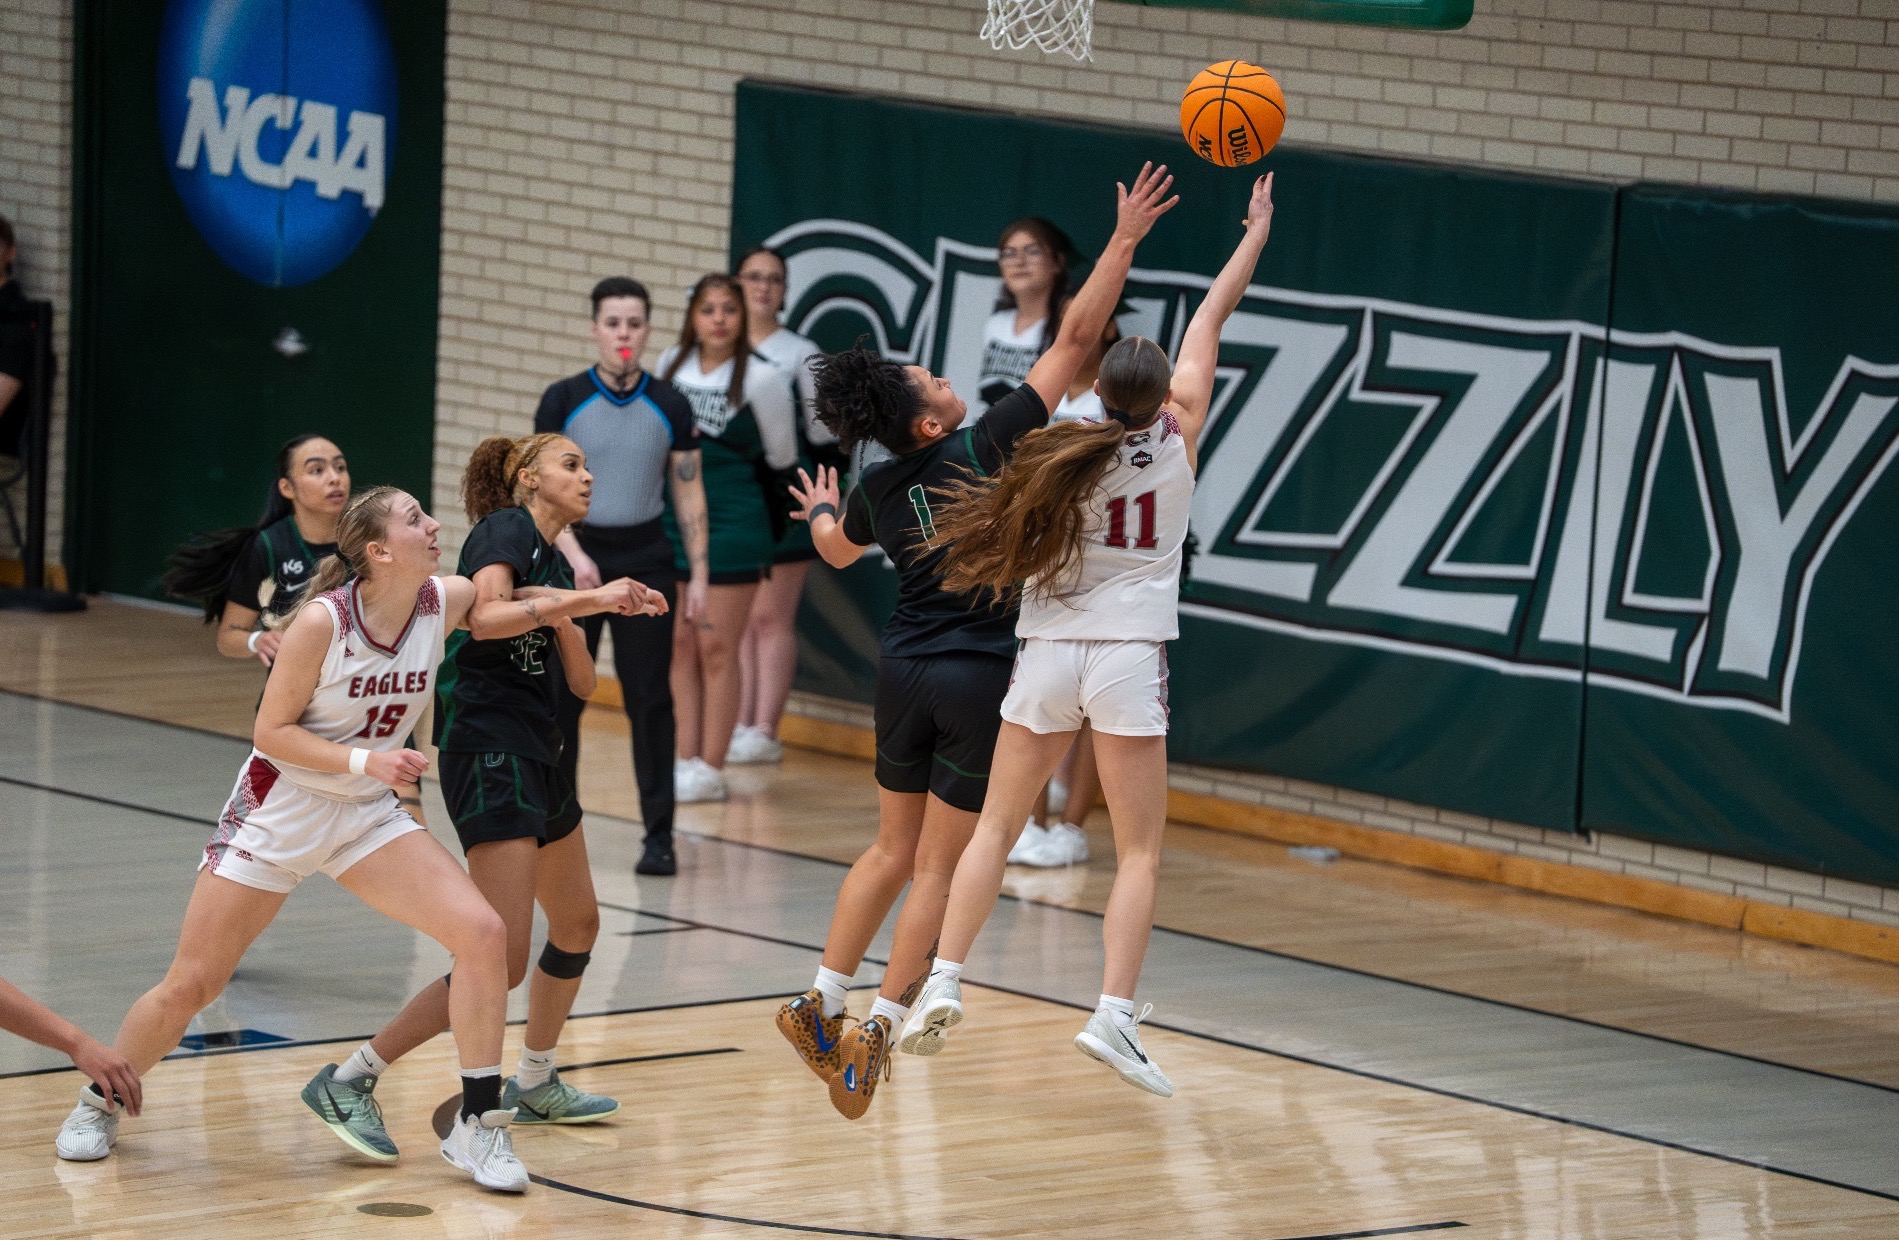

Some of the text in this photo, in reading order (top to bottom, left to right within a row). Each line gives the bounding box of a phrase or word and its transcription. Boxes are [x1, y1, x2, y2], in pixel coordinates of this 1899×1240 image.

[176, 77, 386, 214] NCAA
[1103, 490, 1160, 551] 11
[348, 670, 428, 698] EAGLES
[354, 703, 408, 739] 15
